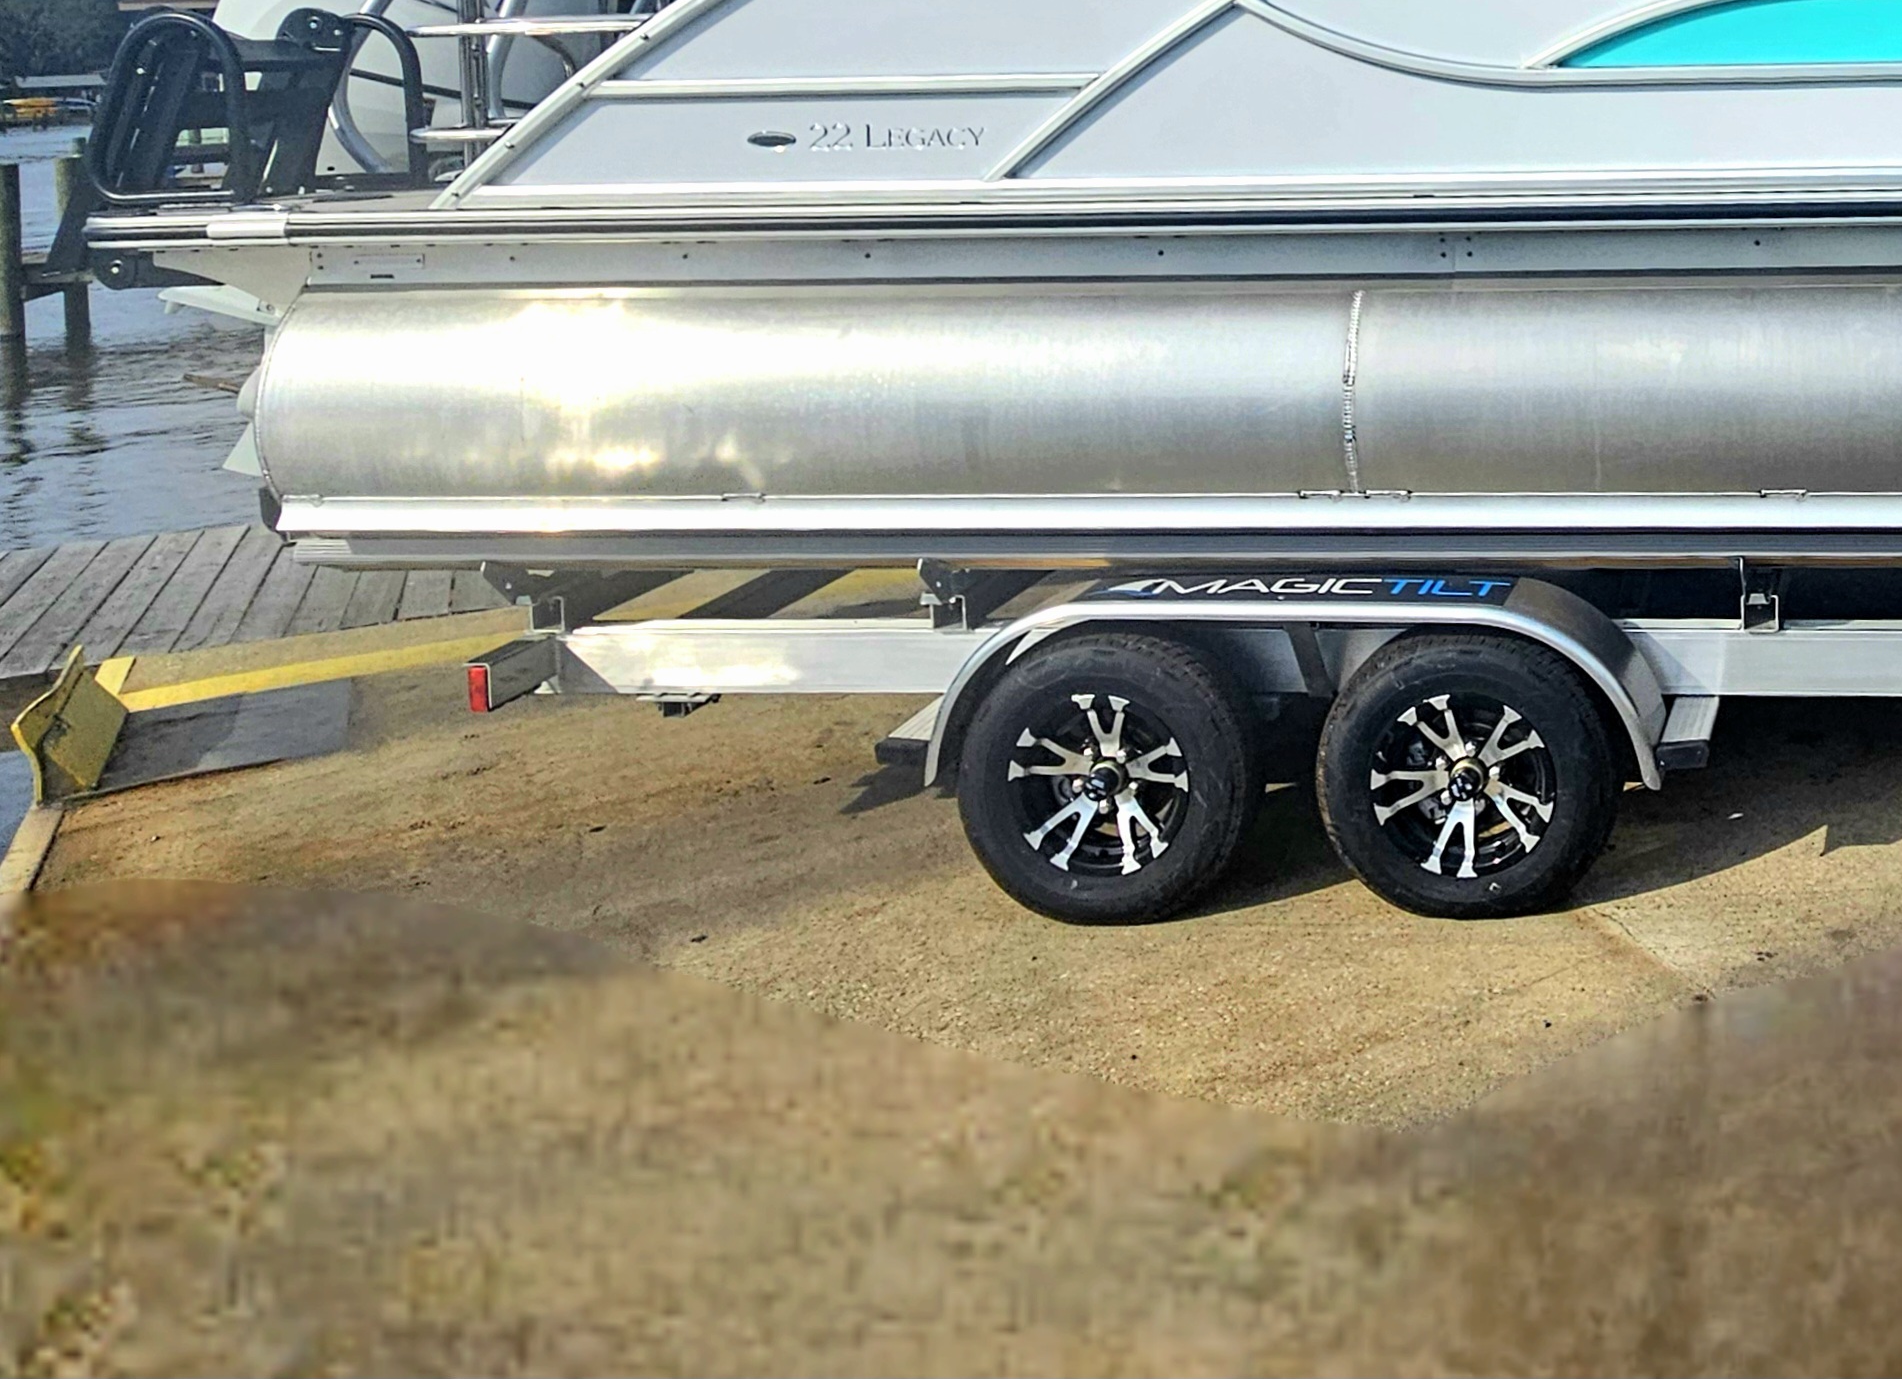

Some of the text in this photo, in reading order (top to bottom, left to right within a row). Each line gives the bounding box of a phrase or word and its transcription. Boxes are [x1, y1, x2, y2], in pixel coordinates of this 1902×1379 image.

[808, 123, 985, 151] 22 LEGACY
[1151, 577, 1511, 597] MAGICTILT
